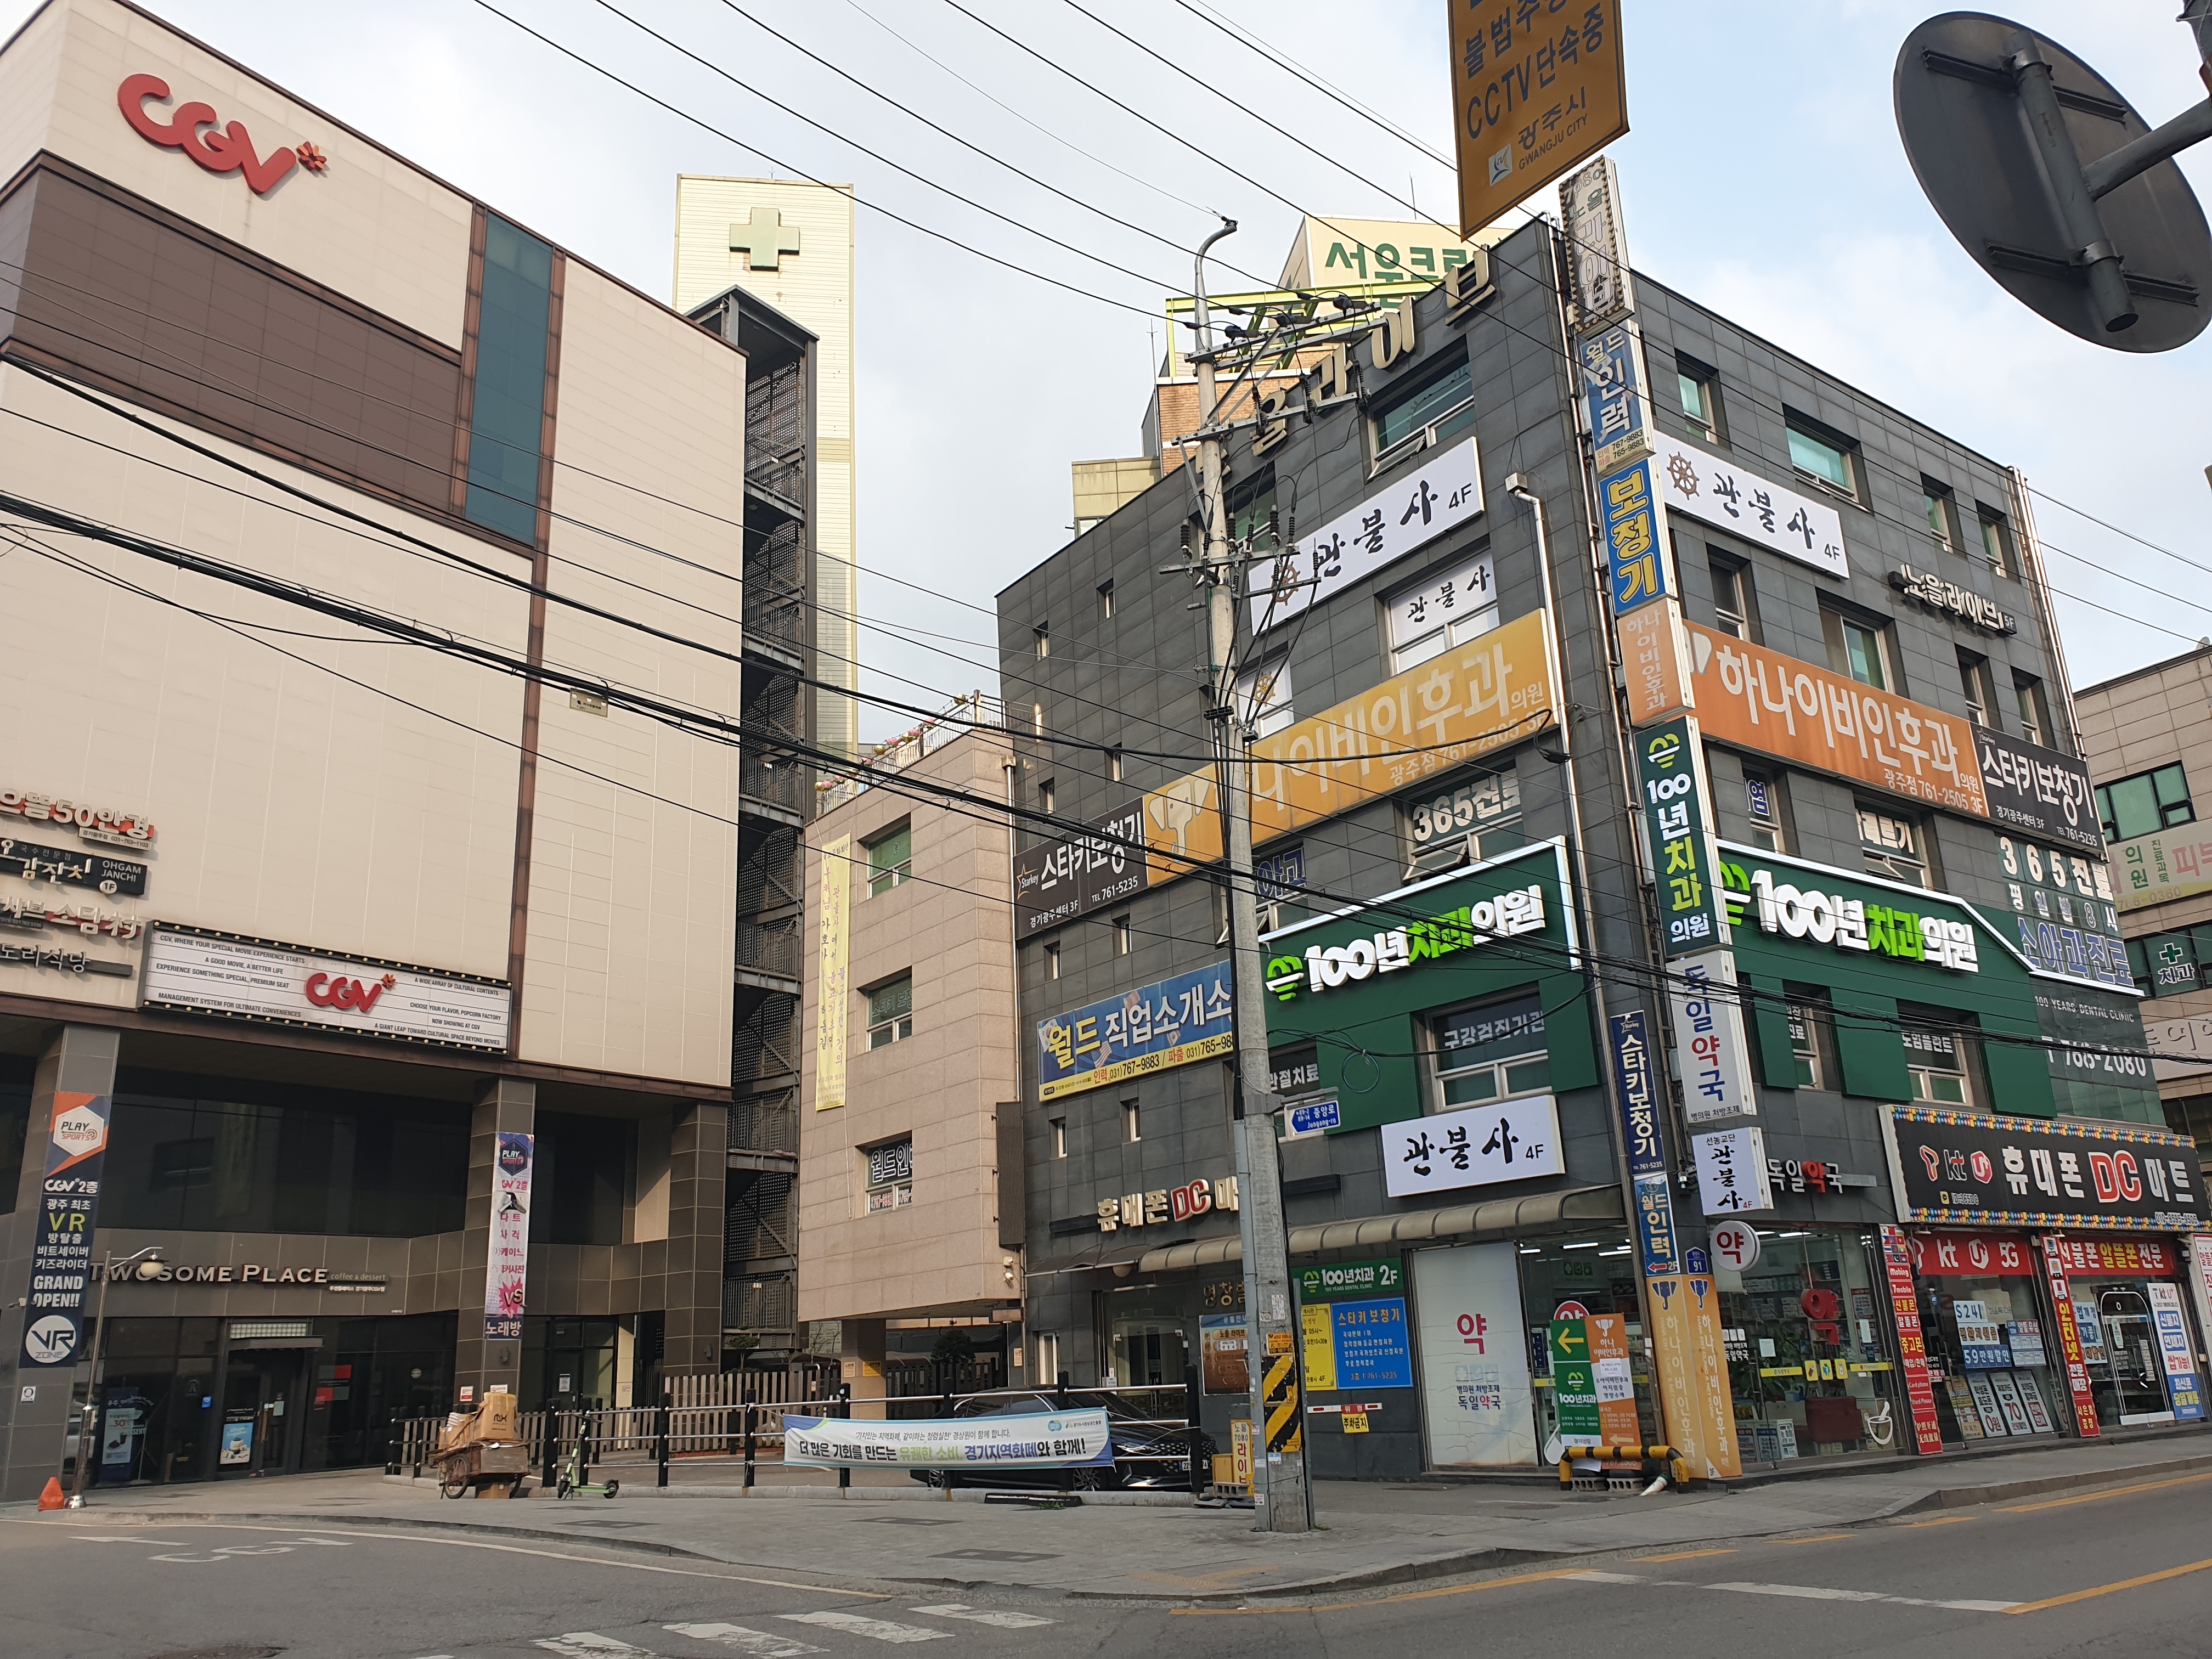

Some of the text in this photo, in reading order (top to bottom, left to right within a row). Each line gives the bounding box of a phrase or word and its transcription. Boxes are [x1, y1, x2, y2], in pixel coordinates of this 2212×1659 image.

[1519, 86, 1587, 150] 광주시
[117, 74, 297, 195] CGV
[1519, 113, 1588, 171] GWANGJU CITY
[1569, 187, 1604, 225] 노을
[1576, 211, 1616, 324] 라이브
[1587, 330, 1626, 364] 월드
[1612, 429, 1643, 451] 767-9883
[1613, 438, 1645, 460] 765-9883
[1317, 480, 1472, 577] 관불사 4F
[1713, 472, 1840, 560] 관불사 4F
[1609, 469, 1659, 603] 보청기
[1408, 565, 1491, 622] 관불사
[1901, 563, 2015, 631] 노을라이브 5F
[1626, 610, 1661, 634] 하나
[1637, 631, 1668, 712] 이비인후과
[1214, 642, 1545, 817] 나이비인후과 의원
[1715, 645, 1981, 794] 하나이비인후과 의원
[1389, 719, 1520, 787] 광주점 761-2505
[1883, 768, 1984, 815] 광주점 761-2505 3F
[1982, 744, 2095, 826] 스타키보청기
[0, 788, 150, 839] 으뜸50안경
[111, 836, 149, 848] 031-763-1103
[2066, 827, 2097, 847] 761-5235
[1042, 811, 1142, 891] 스타키보청기
[101, 870, 137, 883] JANCHI
[102, 860, 142, 874] OHGAM
[104, 882, 115, 891] 1F
[1021, 872, 1039, 888] Starkey
[1092, 876, 1138, 903] TEL 761-5235
[1070, 900, 1079, 912] 3F
[1750, 869, 1979, 973] 100년치과의원
[174, 938, 305, 964] WHERE YOUR SPECIAL MOVIE EXPERIENCE STARTS
[1304, 884, 1547, 993] 100년치과의원
[2018, 917, 2135, 988] 소아과진료
[156, 963, 190, 974] EXPERIENCE
[192, 968, 224, 979] SOMETHING
[250, 978, 275, 987] PREMIUM
[252, 964, 272, 973] BETTER
[2157, 962, 2195, 986] 치과
[304, 972, 382, 1013] CGV
[454, 984, 476, 992] CULTURAL
[477, 987, 499, 996] CONTENTS
[2035, 996, 2049, 1007] 100
[159, 992, 199, 1003] MANAGEMENT
[200, 998, 222, 1007] SYSTEM
[235, 1003, 261, 1012] ULTIMATE
[262, 1007, 301, 1018] CONVENIENCES
[461, 1010, 481, 1018] POPCORN
[482, 1013, 501, 1021] FACTORY
[427, 1030, 449, 1039] CULTURAL
[443, 1020, 464, 1028] SHOWING
[1048, 979, 1232, 1070] 월드 직업소개소
[1683, 964, 1725, 1102] 독일약국
[1093, 1068, 1107, 1085] 인력
[1168, 1047, 1184, 1064] 파출
[1621, 1034, 1656, 1157] 스타키보청기
[1307, 1118, 1336, 1129] Jungang-ro
[1313, 1104, 1336, 1119] 중앙로
[61, 1121, 89, 1131] PLAY
[1403, 1118, 1544, 1176] 관불사 4F
[1706, 1134, 1735, 1146] 선농교단
[1640, 1161, 1663, 1170] 761-5235
[1711, 1145, 1743, 1210] 관불사
[1767, 1158, 1843, 1194] 독일약국
[2002, 1146, 2194, 1203] 휴대폰 DC 마트
[44, 1179, 76, 1192] CGV
[47, 1199, 91, 1210] 광주 최초
[1097, 1179, 1211, 1232] 휴대폰 DC
[49, 1213, 86, 1232] VR
[37, 1245, 89, 1257] 비트세이버
[48, 1233, 82, 1244] 방탈출
[1717, 1232, 1745, 1265] 약
[35, 1259, 88, 1270] 키즈라이더
[1937, 1239, 2019, 1268] kt 5G
[2100, 1243, 2165, 1269] 알뜰폰 전문
[241, 1264, 328, 1283] PLACE
[1321, 1265, 1398, 1286] 100년치과 2F
[1693, 1261, 1703, 1272] 91
[34, 1276, 83, 1290] GRAND
[33, 1293, 80, 1307] OPEN!!
[1338, 1308, 1400, 1326] 스타키 보청기
[1801, 1288, 1839, 1346] 약
[31, 1330, 75, 1352] VR
[485, 1322, 522, 1338] 노래방
[1457, 1313, 1488, 1355] 약
[2058, 1303, 2080, 1361] 인터넷
[1458, 1395, 1502, 1411] 독일약국
[1559, 1392, 1598, 1404] 100년치과
[903, 1428, 1011, 1441] 같이하는 함께 합니다.
[1344, 1416, 1368, 1430] 주차금지
[799, 1437, 1087, 1462] 더 많은 기회를 만드는 유쾌한 경기지역화폐와 함께!
